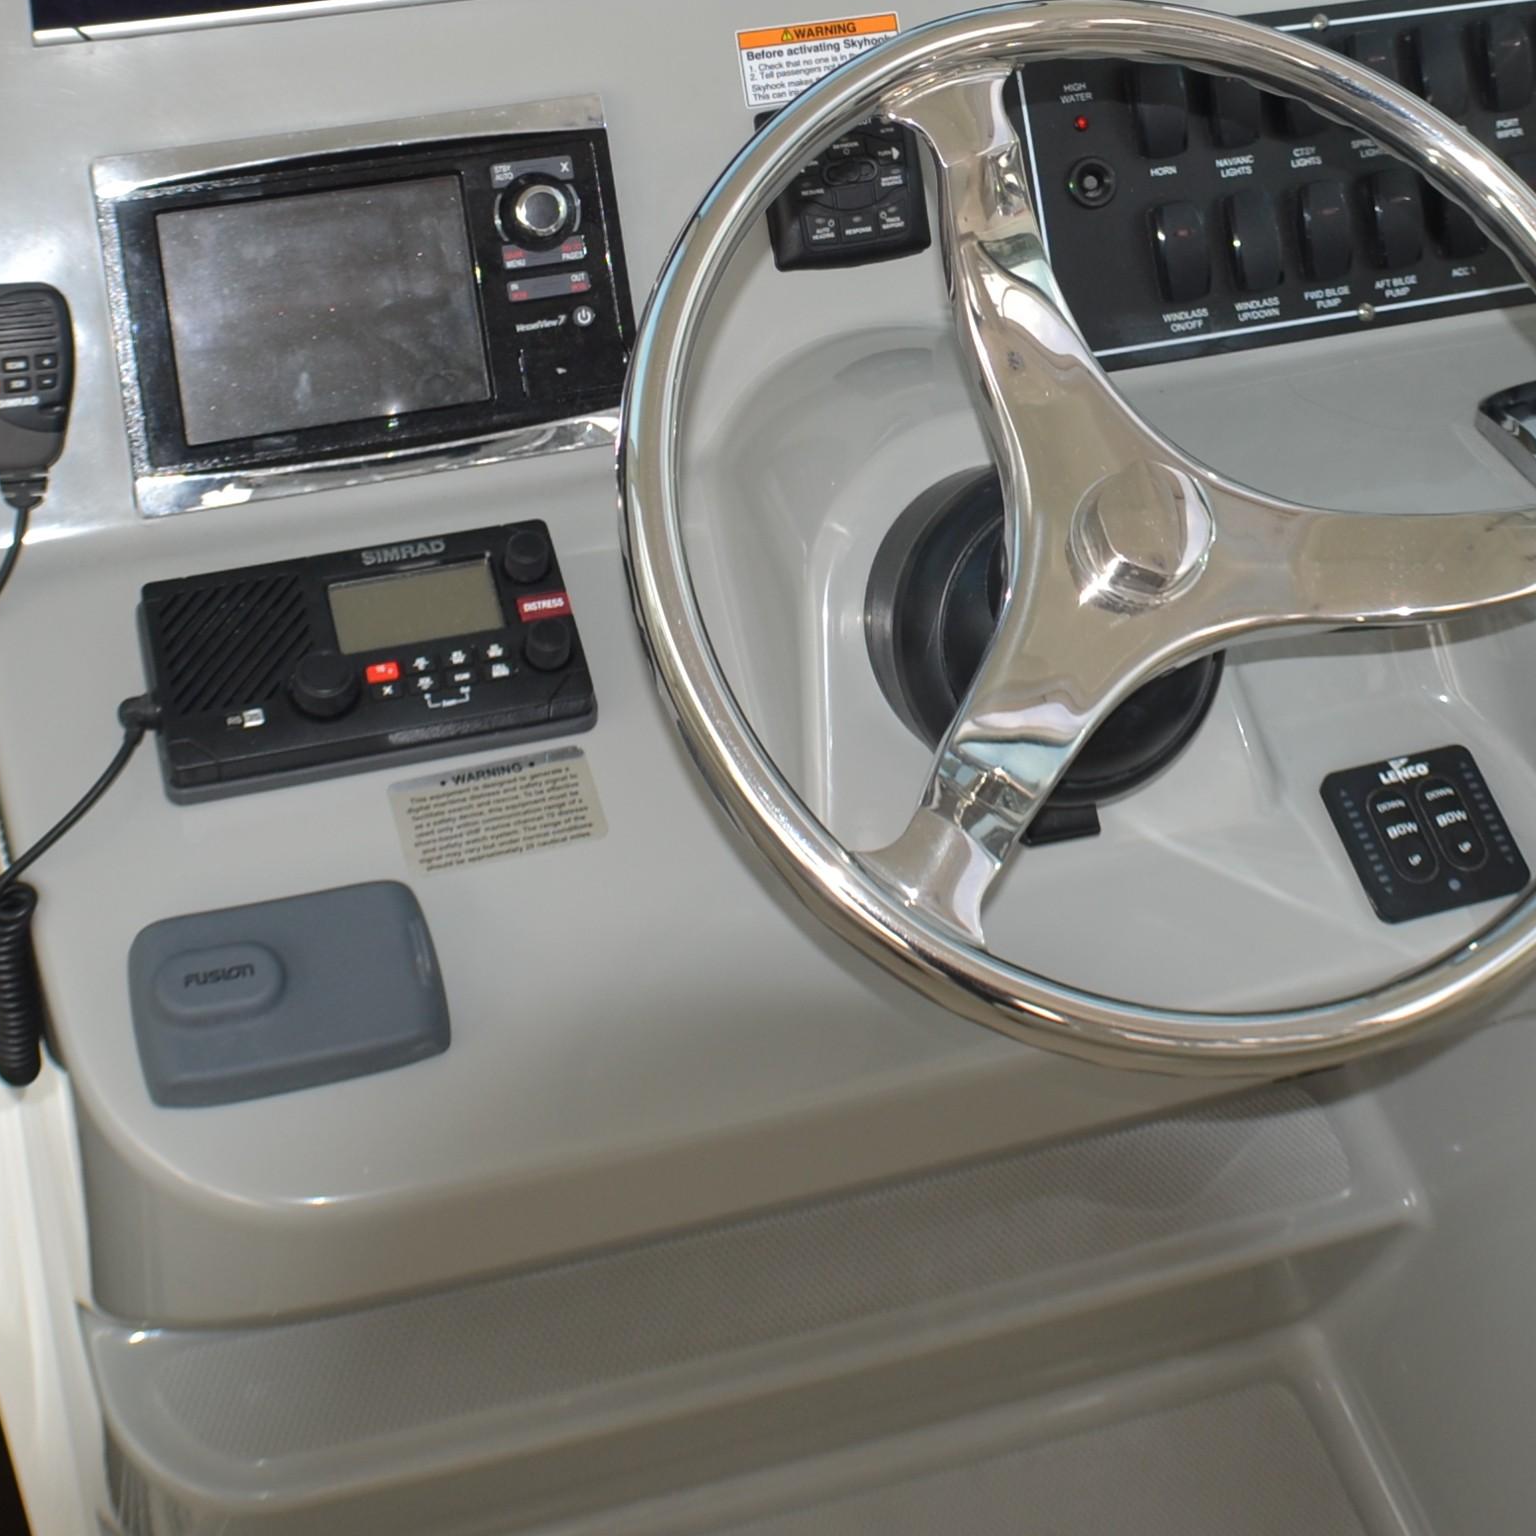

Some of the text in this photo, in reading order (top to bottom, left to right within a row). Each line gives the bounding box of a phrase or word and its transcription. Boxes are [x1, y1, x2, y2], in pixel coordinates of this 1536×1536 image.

[794, 21, 856, 40] WARNING
[746, 47, 784, 61] Before
[785, 40, 840, 58] activating
[758, 61, 783, 71] Check
[784, 59, 800, 68] that
[759, 71, 775, 79] Tell
[776, 65, 822, 79] passengers
[751, 80, 785, 93] Skyhook
[1063, 82, 1087, 94] HIGH
[752, 92, 770, 101] This
[1060, 91, 1094, 105] WATER
[1290, 156, 1322, 168] LIGHTS
[495, 172, 514, 182] AUTO
[1149, 165, 1178, 177] HORN
[1220, 166, 1253, 178] LIGHTS
[570, 274, 586, 283] OUT
[1375, 275, 1418, 290] AFT BILGE
[1325, 285, 1351, 298] BILGE
[1385, 287, 1411, 299] PUMP
[1233, 296, 1281, 312] WINDLASS
[1316, 297, 1342, 310] PUMP
[1162, 307, 1209, 323] WINDLASS
[1170, 319, 1204, 333] ON/OFF
[362, 540, 446, 565] SIMRAD
[522, 596, 565, 613] DISTRESS
[451, 761, 523, 785] WARNING
[1378, 762, 1430, 786] LENCO
[1386, 809, 1468, 840] BOW BOW
[1408, 841, 1472, 866] UP UP
